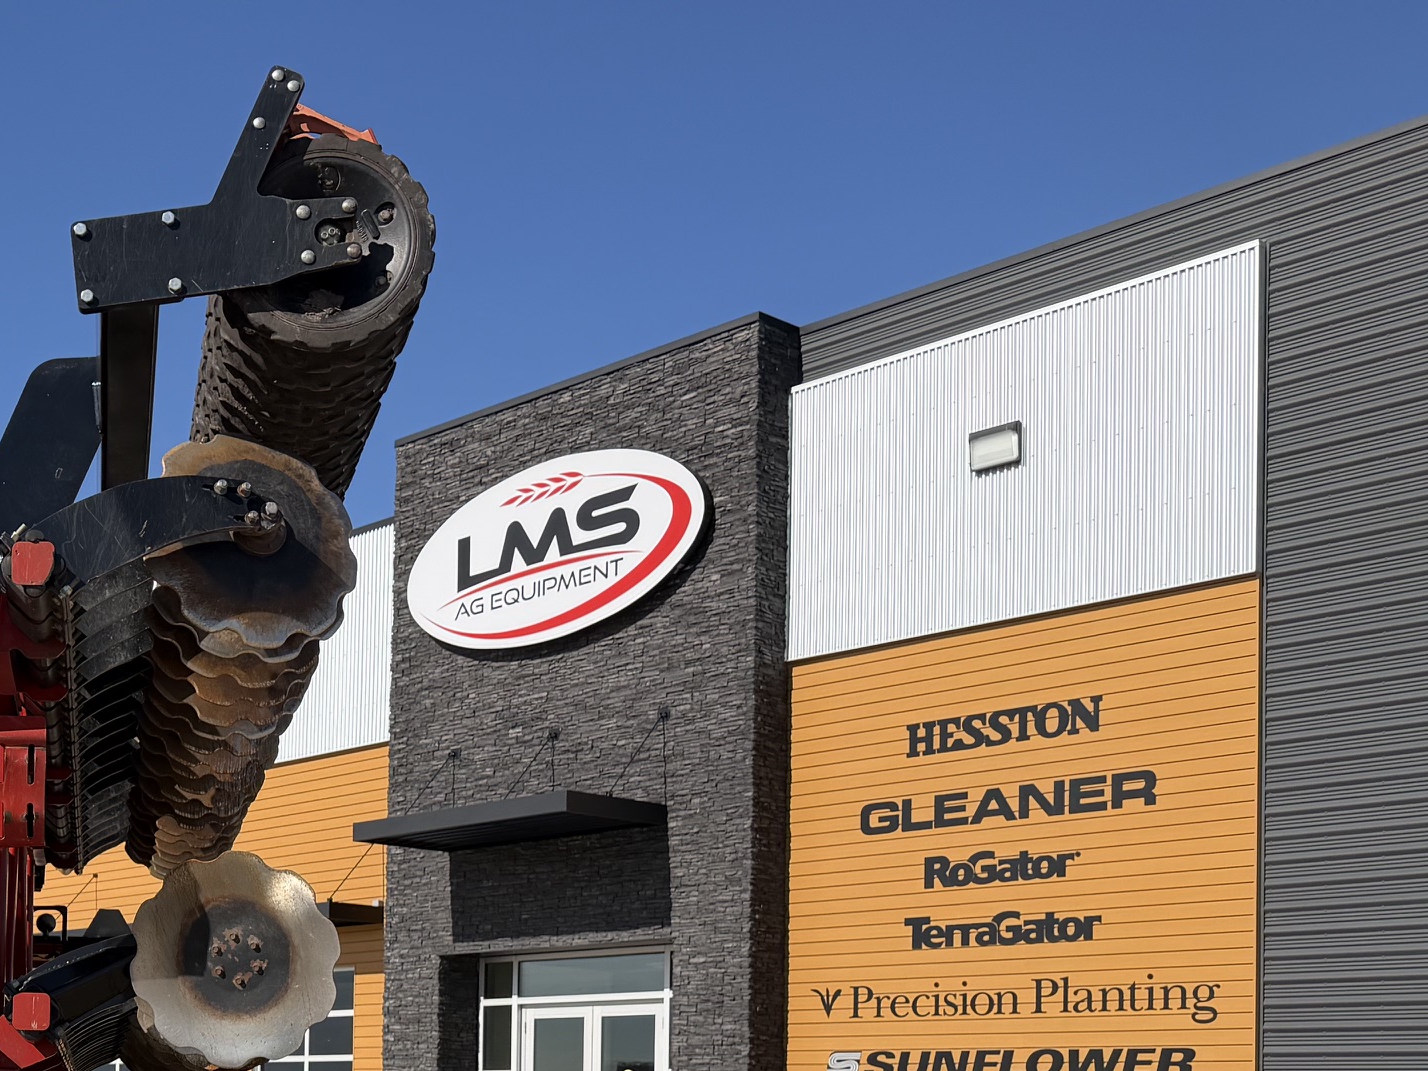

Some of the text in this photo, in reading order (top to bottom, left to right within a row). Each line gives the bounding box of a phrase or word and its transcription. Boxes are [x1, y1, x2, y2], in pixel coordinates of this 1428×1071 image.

[457, 482, 640, 593] LMS
[454, 557, 624, 621] AG EQUIPMENT
[906, 695, 1103, 758] HESSTON
[860, 769, 1158, 836] GLEANER
[923, 850, 1076, 889] RoGator
[904, 910, 1102, 950] TerraGator
[848, 973, 1221, 1024] Precision Planting
